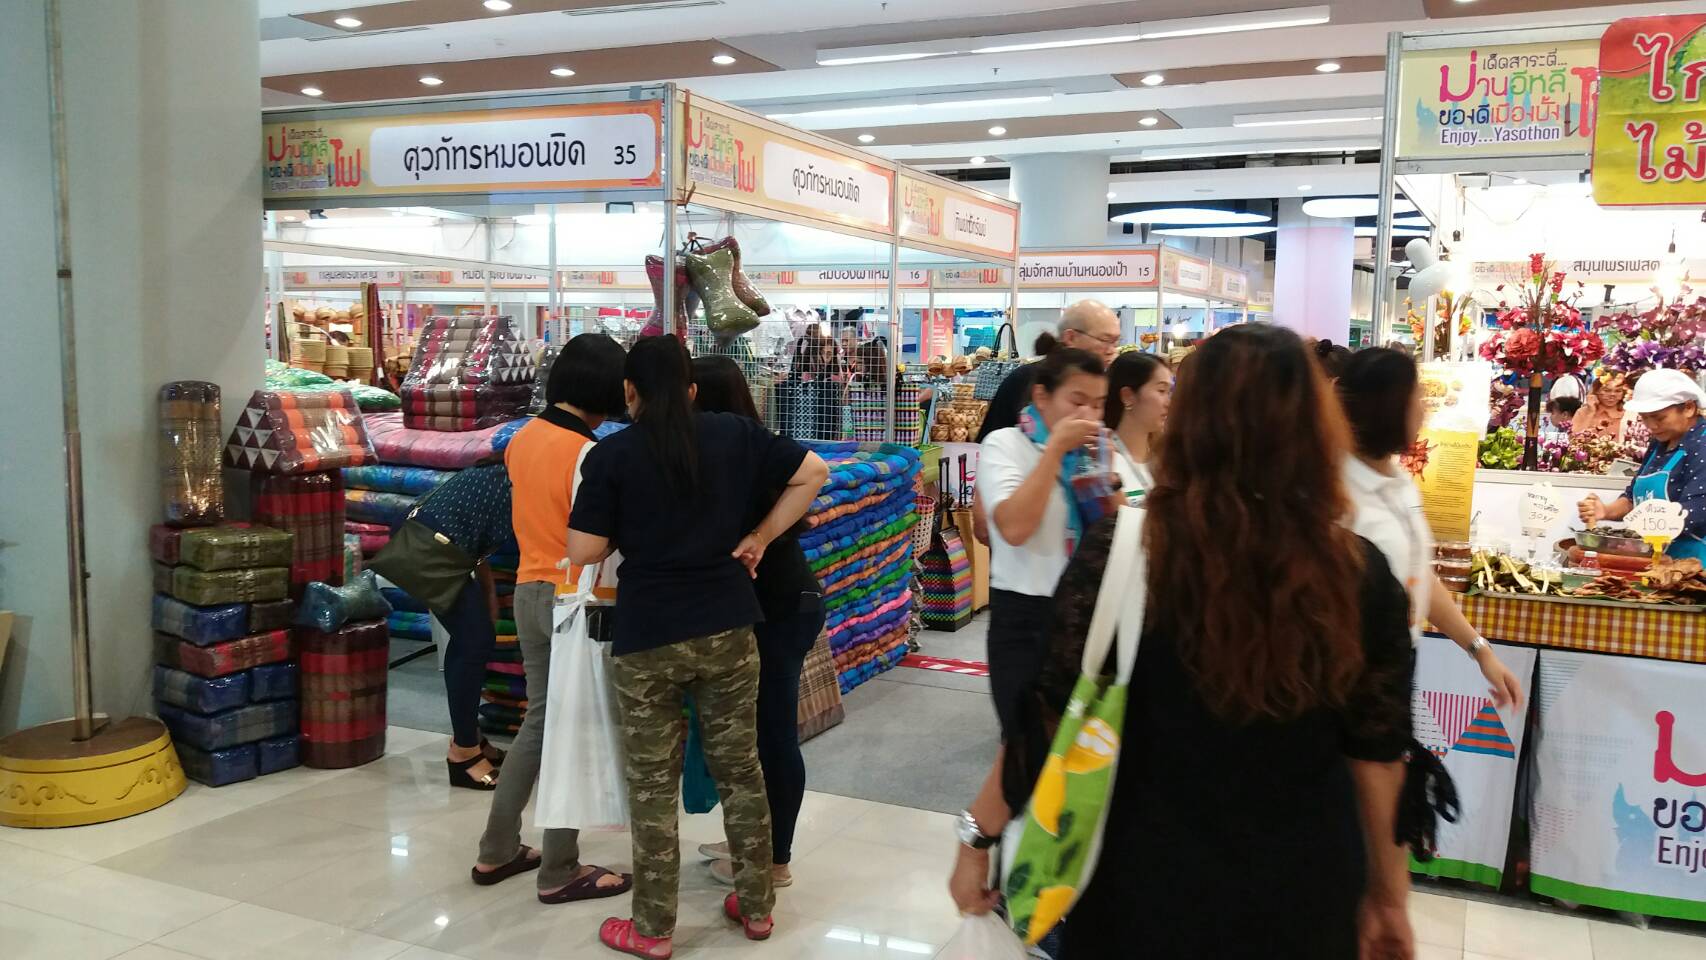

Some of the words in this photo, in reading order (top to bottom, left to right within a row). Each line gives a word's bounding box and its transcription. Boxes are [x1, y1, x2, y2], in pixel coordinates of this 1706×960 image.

[614, 144, 637, 165] 35
[910, 270, 920, 280] 16
[1018, 261, 1128, 282] ลุ่มจักสานบ้านหนองเป้า
[1138, 267, 1150, 277] 15
